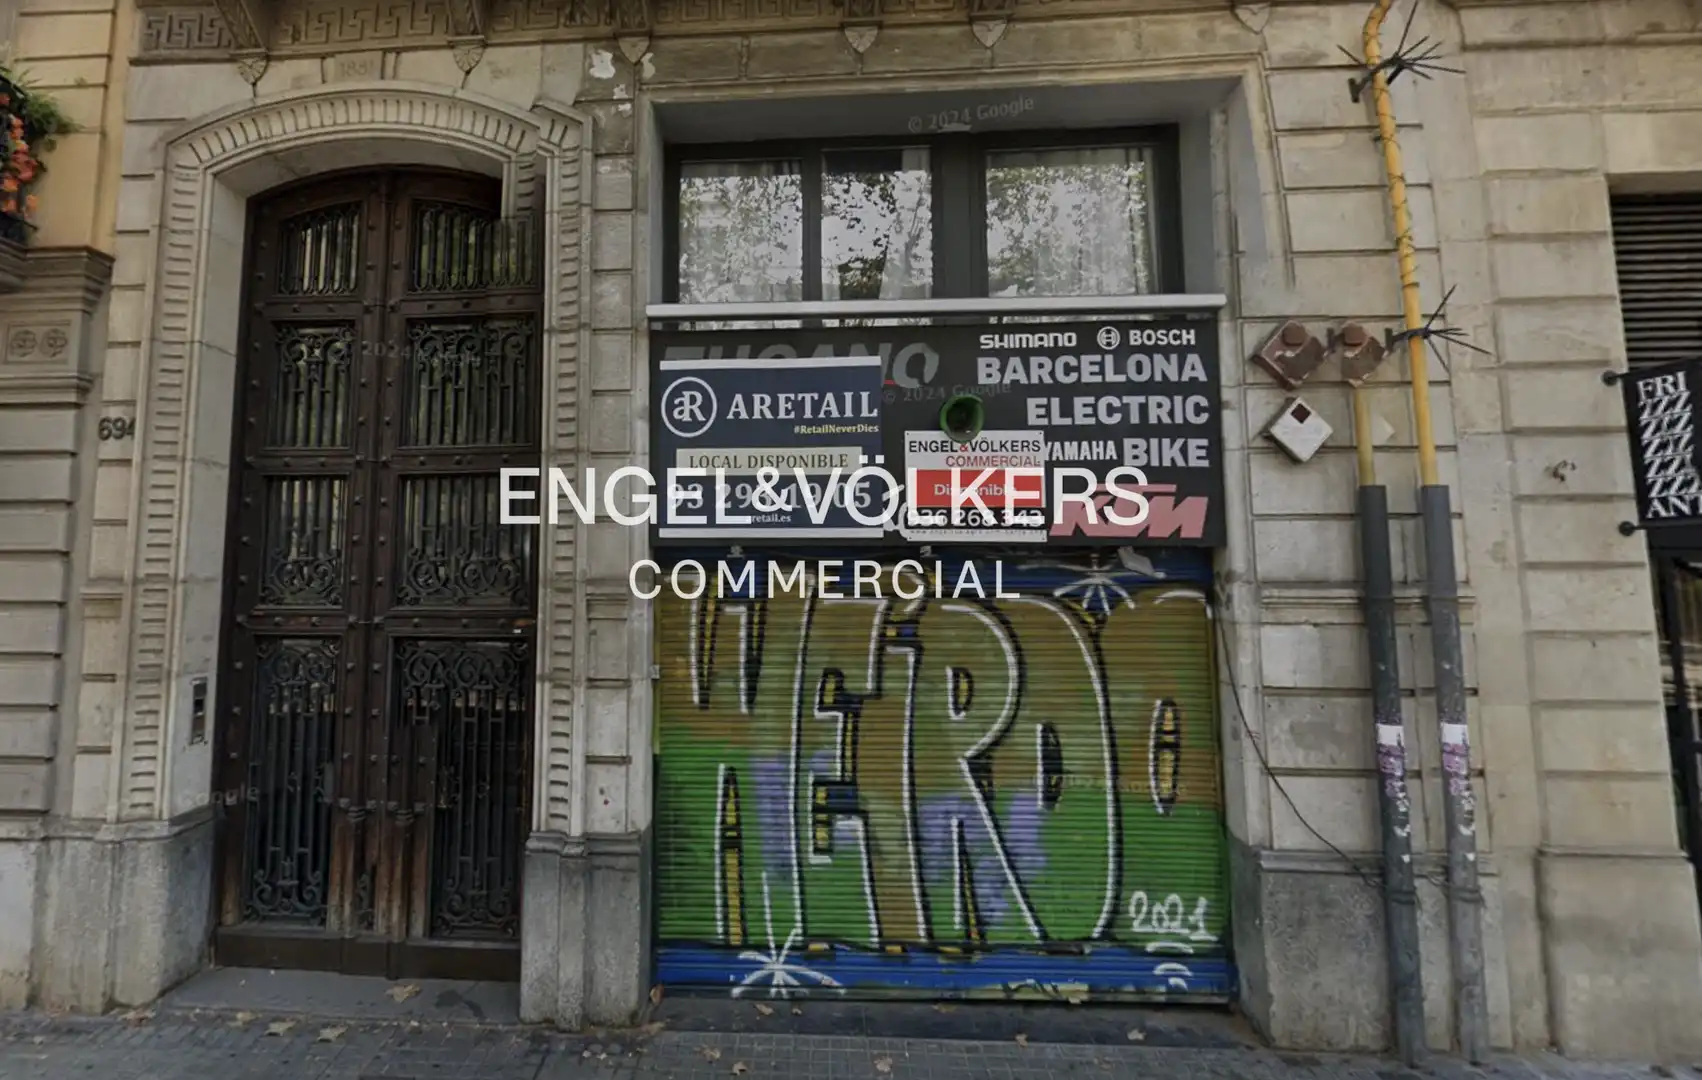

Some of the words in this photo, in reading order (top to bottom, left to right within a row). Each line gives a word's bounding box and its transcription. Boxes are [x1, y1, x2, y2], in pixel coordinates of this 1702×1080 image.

[979, 332, 1077, 349] SHIMANO
[1129, 329, 1196, 346] BOSCH
[977, 353, 1208, 385] BARCELONA
[1636, 370, 1687, 402] FRI
[726, 391, 879, 420] ARETAIL
[1027, 395, 1210, 426] ELECTRIC
[793, 423, 880, 434] #RetailNeverDies
[908, 437, 1041, 453] ENGEL&VÖLKERS
[1044, 441, 1118, 461] YAMAHA
[1123, 437, 1210, 467] BIKE
[689, 455, 742, 469] LOCAL
[747, 454, 849, 469] DISPONIBLE
[945, 456, 1041, 468] COMMERCIAL
[667, 482, 705, 509] 93
[783, 481, 823, 509] 19
[832, 481, 872, 509] 05
[906, 509, 948, 527] 936
[952, 509, 995, 527] 268
[1000, 509, 1043, 527] 343
[1049, 484, 1208, 538] KTM
[1128, 891, 1219, 941] 2021
